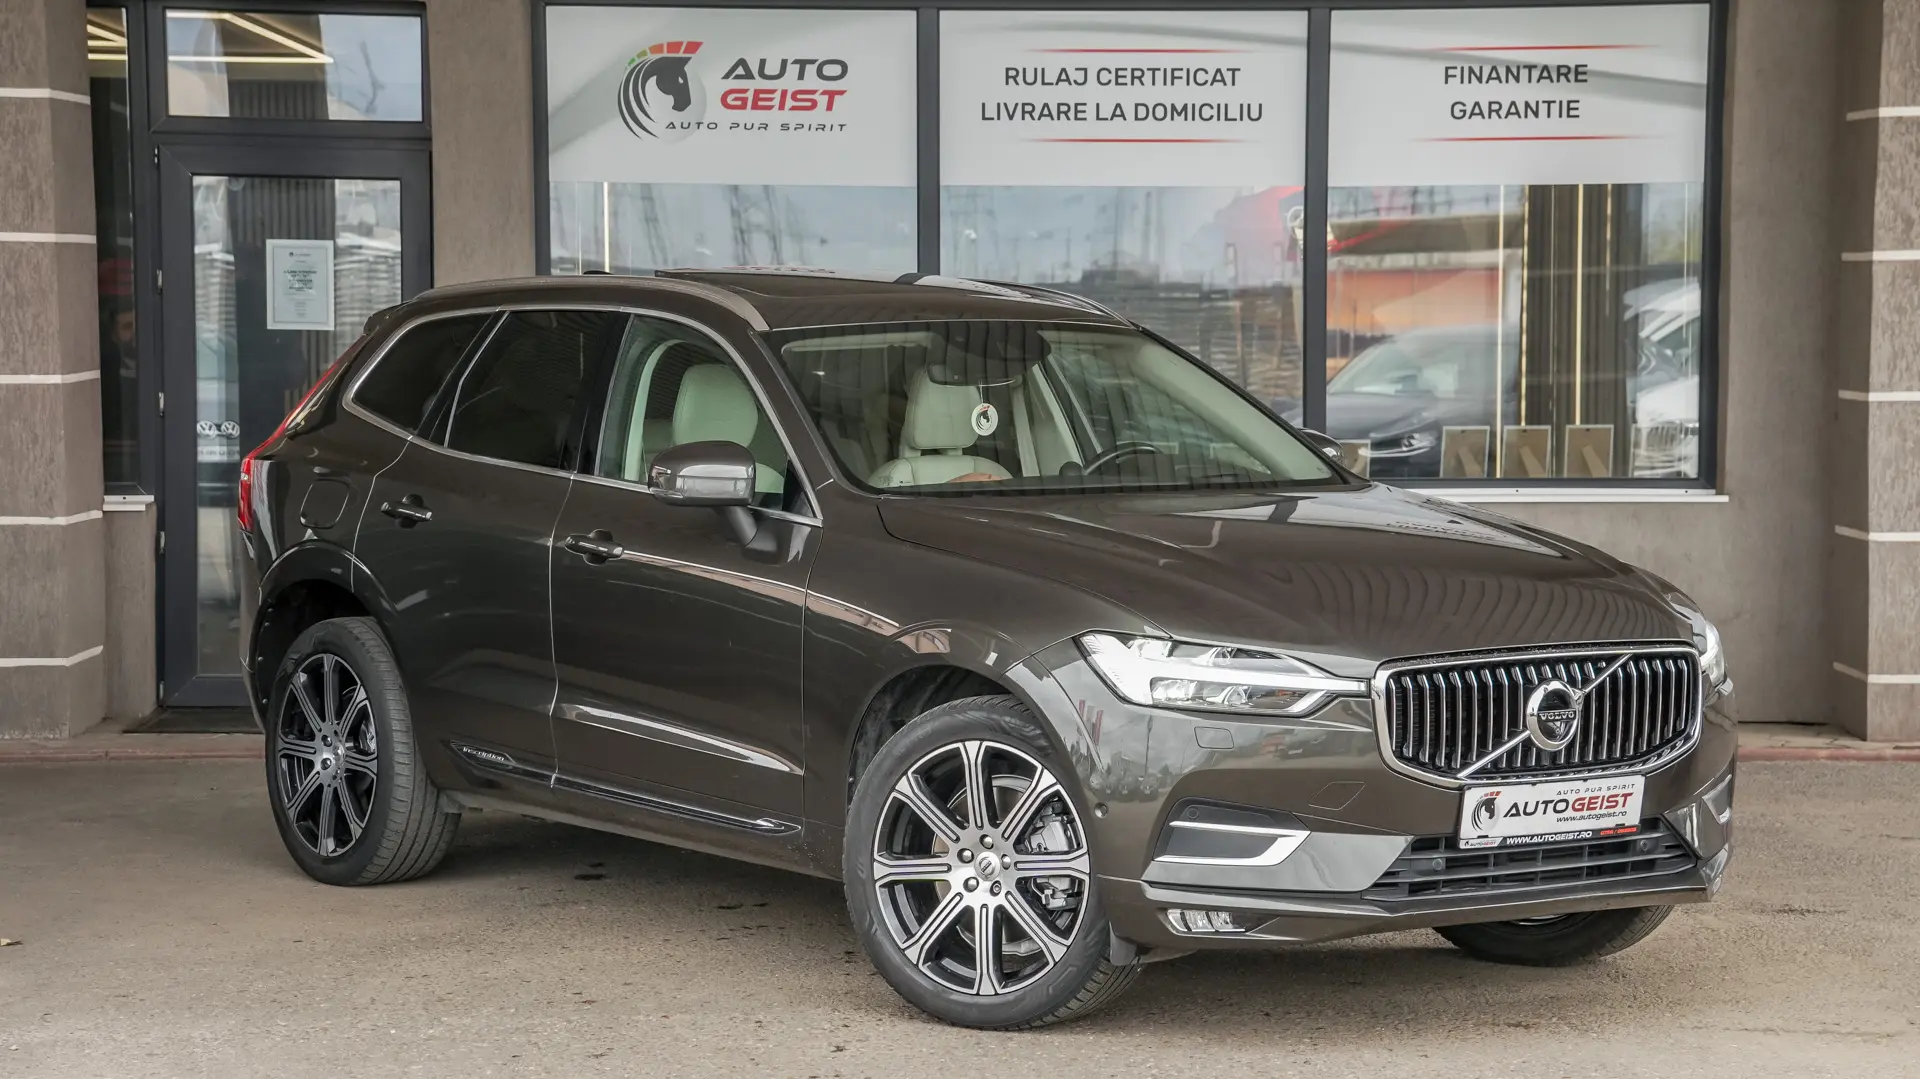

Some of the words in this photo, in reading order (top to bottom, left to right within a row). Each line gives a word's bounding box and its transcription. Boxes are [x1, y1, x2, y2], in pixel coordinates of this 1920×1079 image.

[721, 57, 849, 81] AUTO
[1004, 66, 1088, 87] RULAJ
[1096, 67, 1241, 87] CERTIFICAT
[1444, 63, 1589, 84] FINANTARE
[720, 88, 848, 112] GEIST
[1450, 100, 1580, 120] GARANTIE
[981, 102, 1087, 122] LIVRARE
[1095, 102, 1127, 122] LA
[1133, 102, 1263, 122] DOMICILIU
[665, 121, 718, 131] AUTO
[729, 122, 769, 131] PUR
[780, 122, 847, 132] SPIRIT
[1539, 711, 1575, 720] VOLVO
[1556, 788, 1581, 796] AUTO
[1606, 783, 1636, 792] SPIRIT
[1556, 810, 1628, 823] www.autogeist.ro
[1506, 830, 1593, 845] WWW.AUTOGEIST.RO
